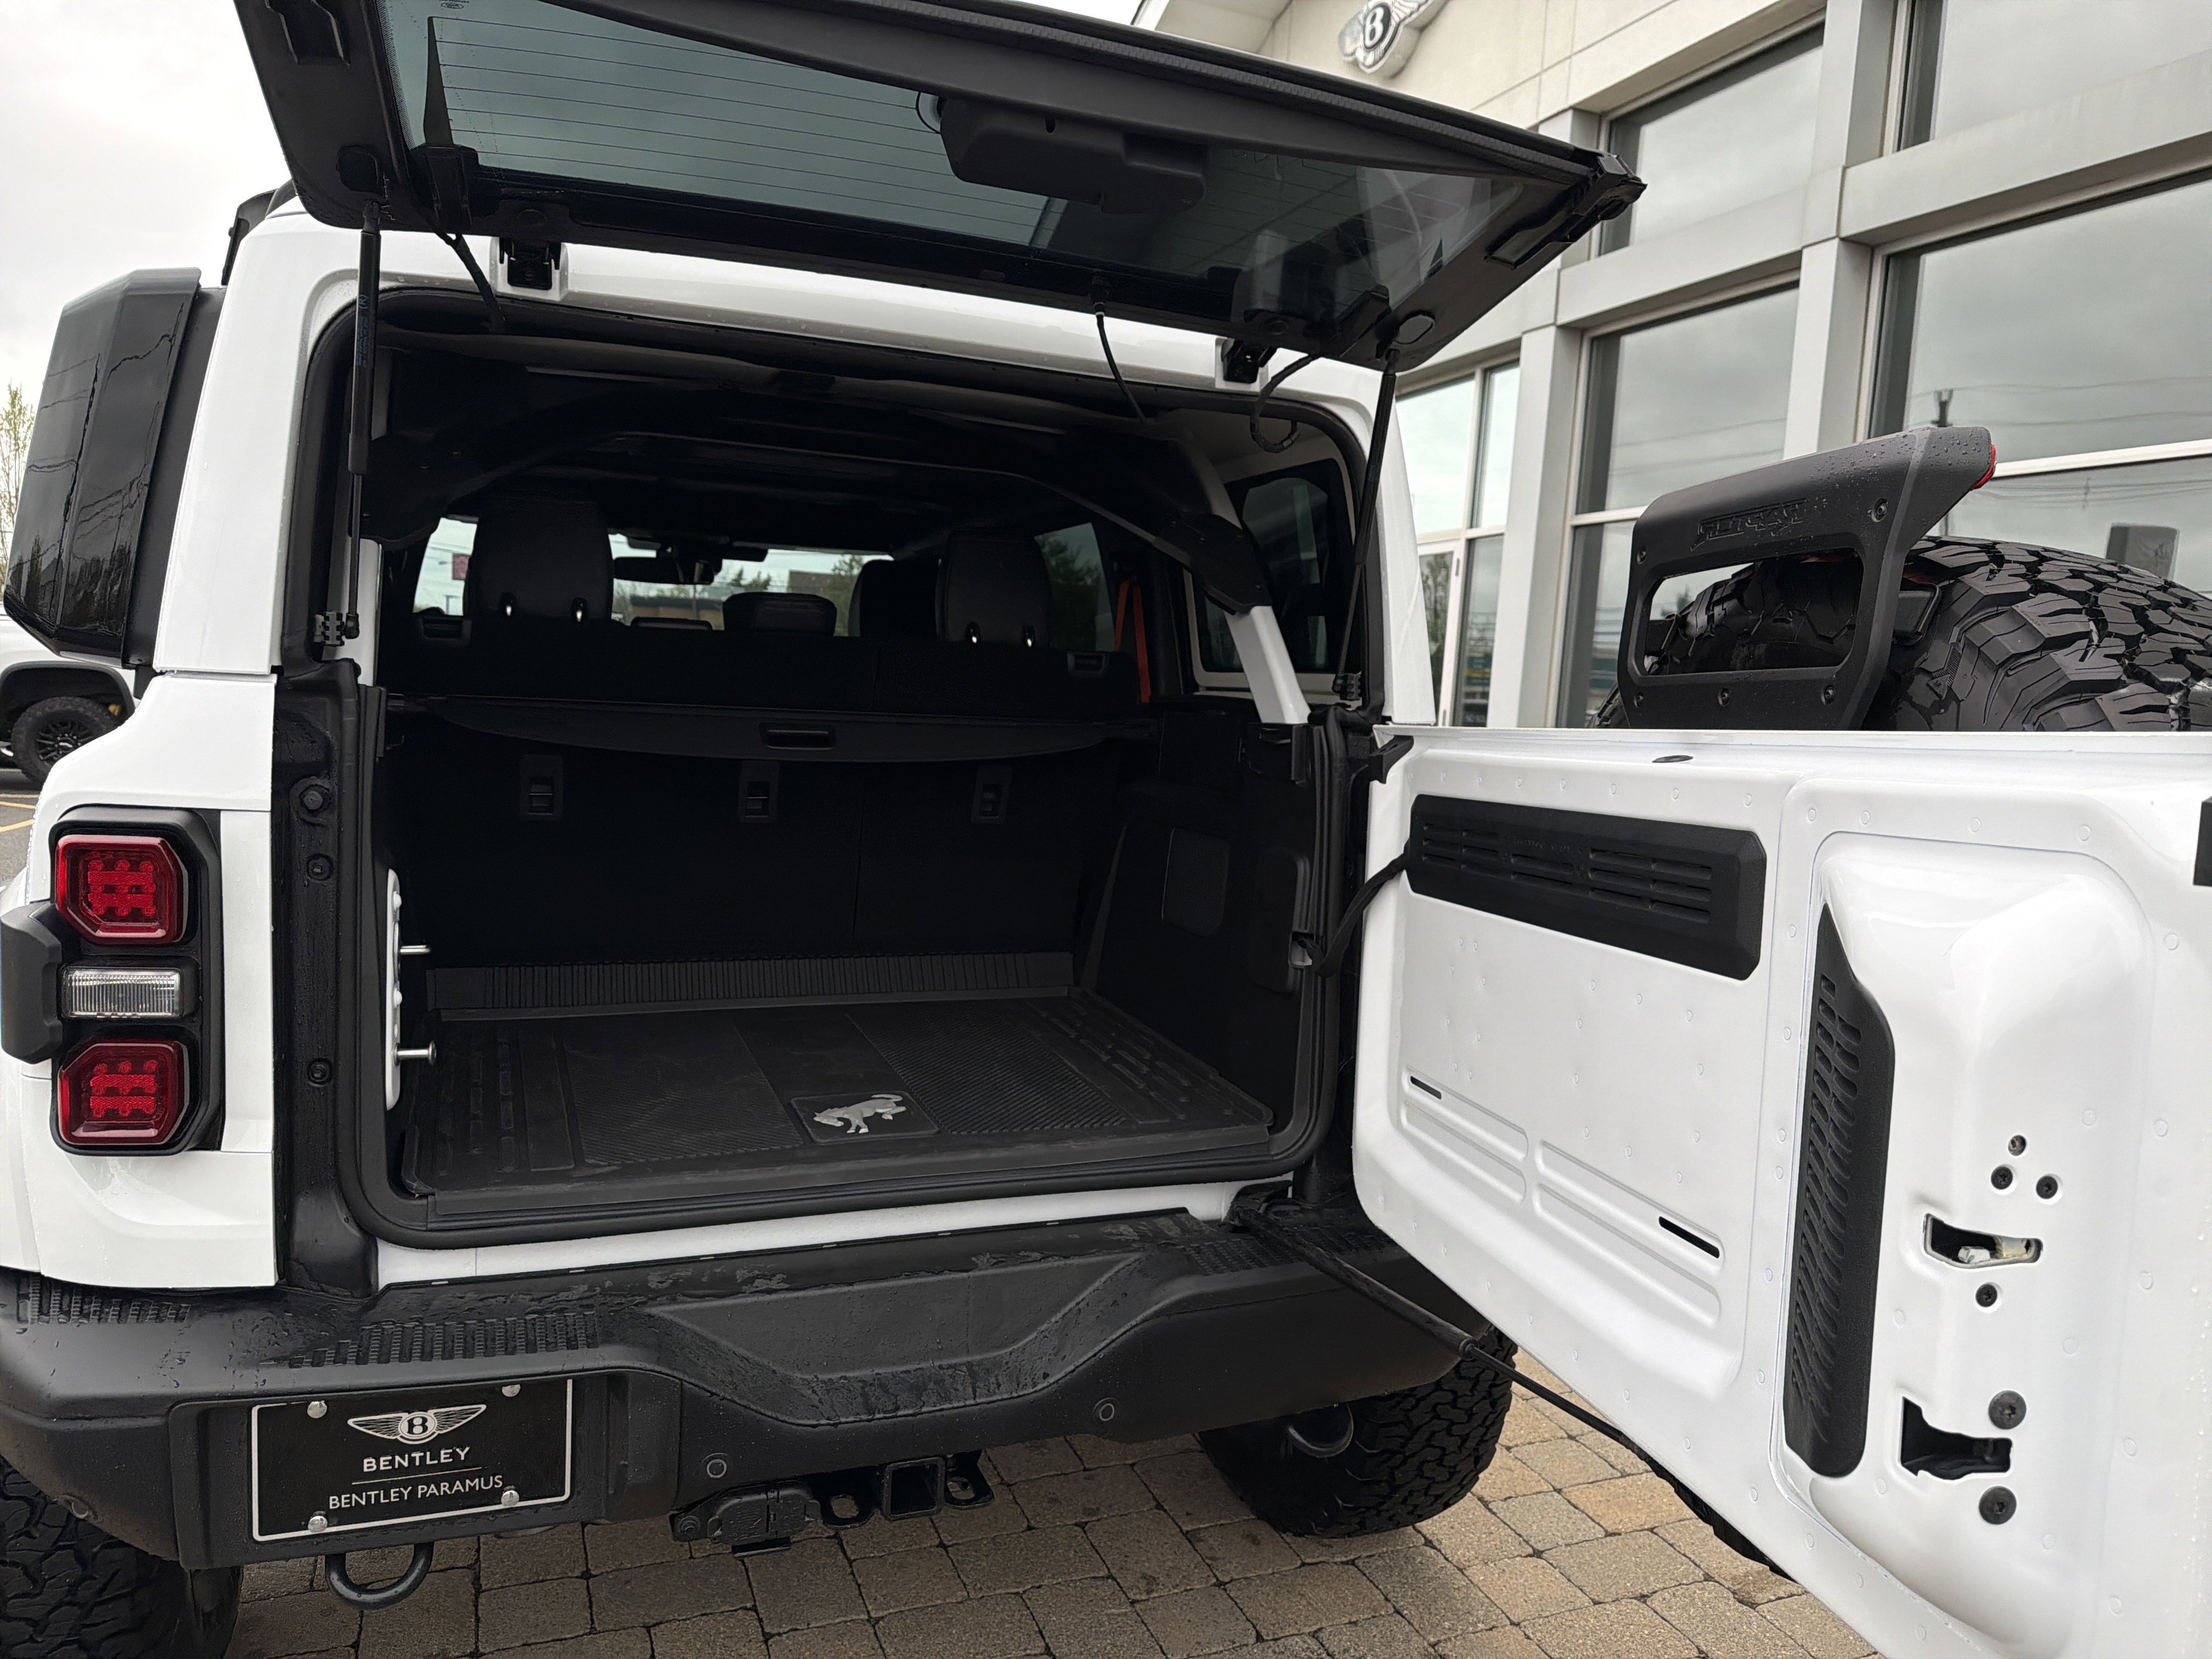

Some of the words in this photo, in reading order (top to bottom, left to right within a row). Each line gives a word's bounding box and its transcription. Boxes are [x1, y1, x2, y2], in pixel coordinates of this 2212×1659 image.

[407, 1416, 428, 1435] B
[363, 1447, 470, 1472] BENTLEY
[329, 1486, 412, 1509] BENTLEY
[417, 1475, 504, 1498] PARAMUS
